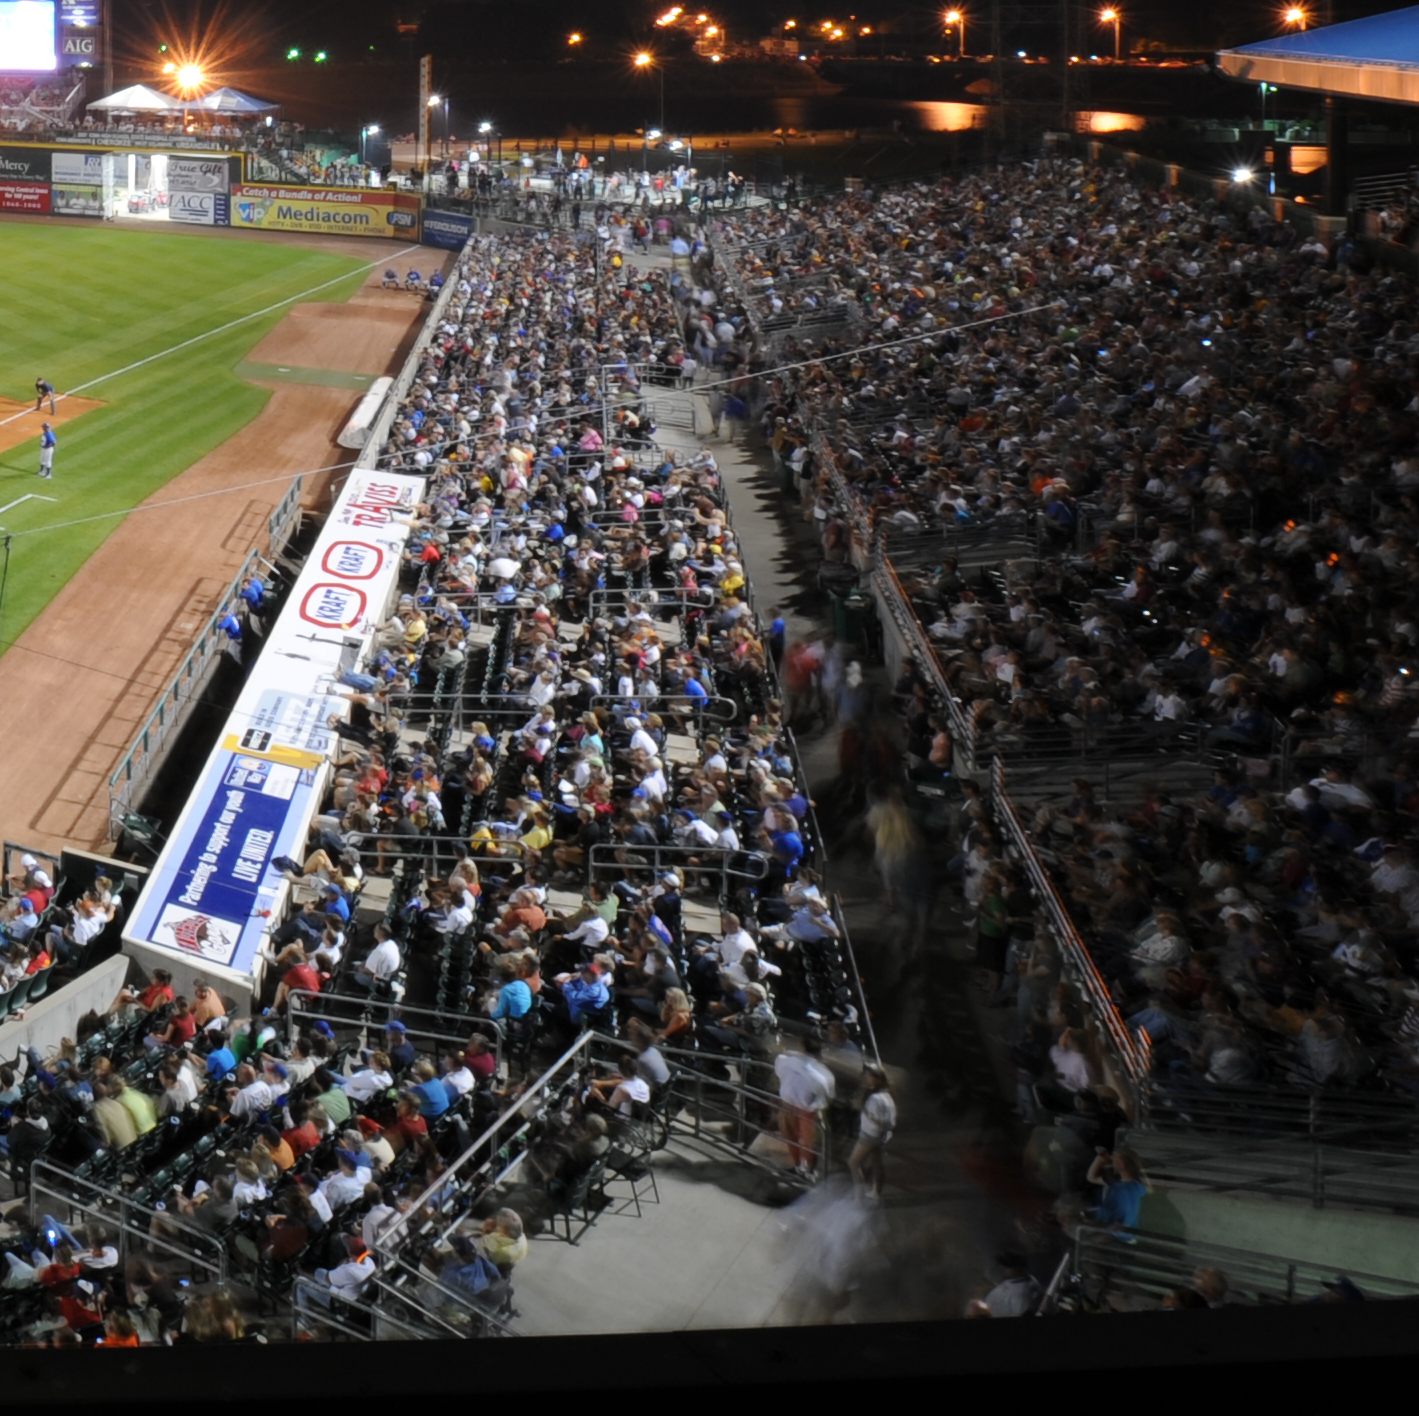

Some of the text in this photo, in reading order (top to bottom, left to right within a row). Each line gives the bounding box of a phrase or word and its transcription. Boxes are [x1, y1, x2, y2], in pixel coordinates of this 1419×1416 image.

[64, 39, 93, 53] AIG
[2, 160, 30, 174] Mercy
[170, 162, 223, 174] True Gift
[243, 187, 269, 197] Catch
[278, 190, 311, 200] Bundle
[313, 191, 322, 200] of
[323, 193, 362, 202] Action!
[239, 202, 266, 223] vip
[277, 206, 370, 225] Mediacom
[391, 213, 412, 225] FSN
[429, 220, 468, 233] FERGUSON
[336, 545, 368, 574] KRAFT
[315, 588, 351, 621] KRAFT
[226, 789, 245, 813] youth
[219, 809, 236, 824] our
[206, 822, 232, 855] support
[198, 853, 218, 864] to
[231, 828, 274, 883] LIVE UNITED.
[179, 861, 218, 905] Partnering
